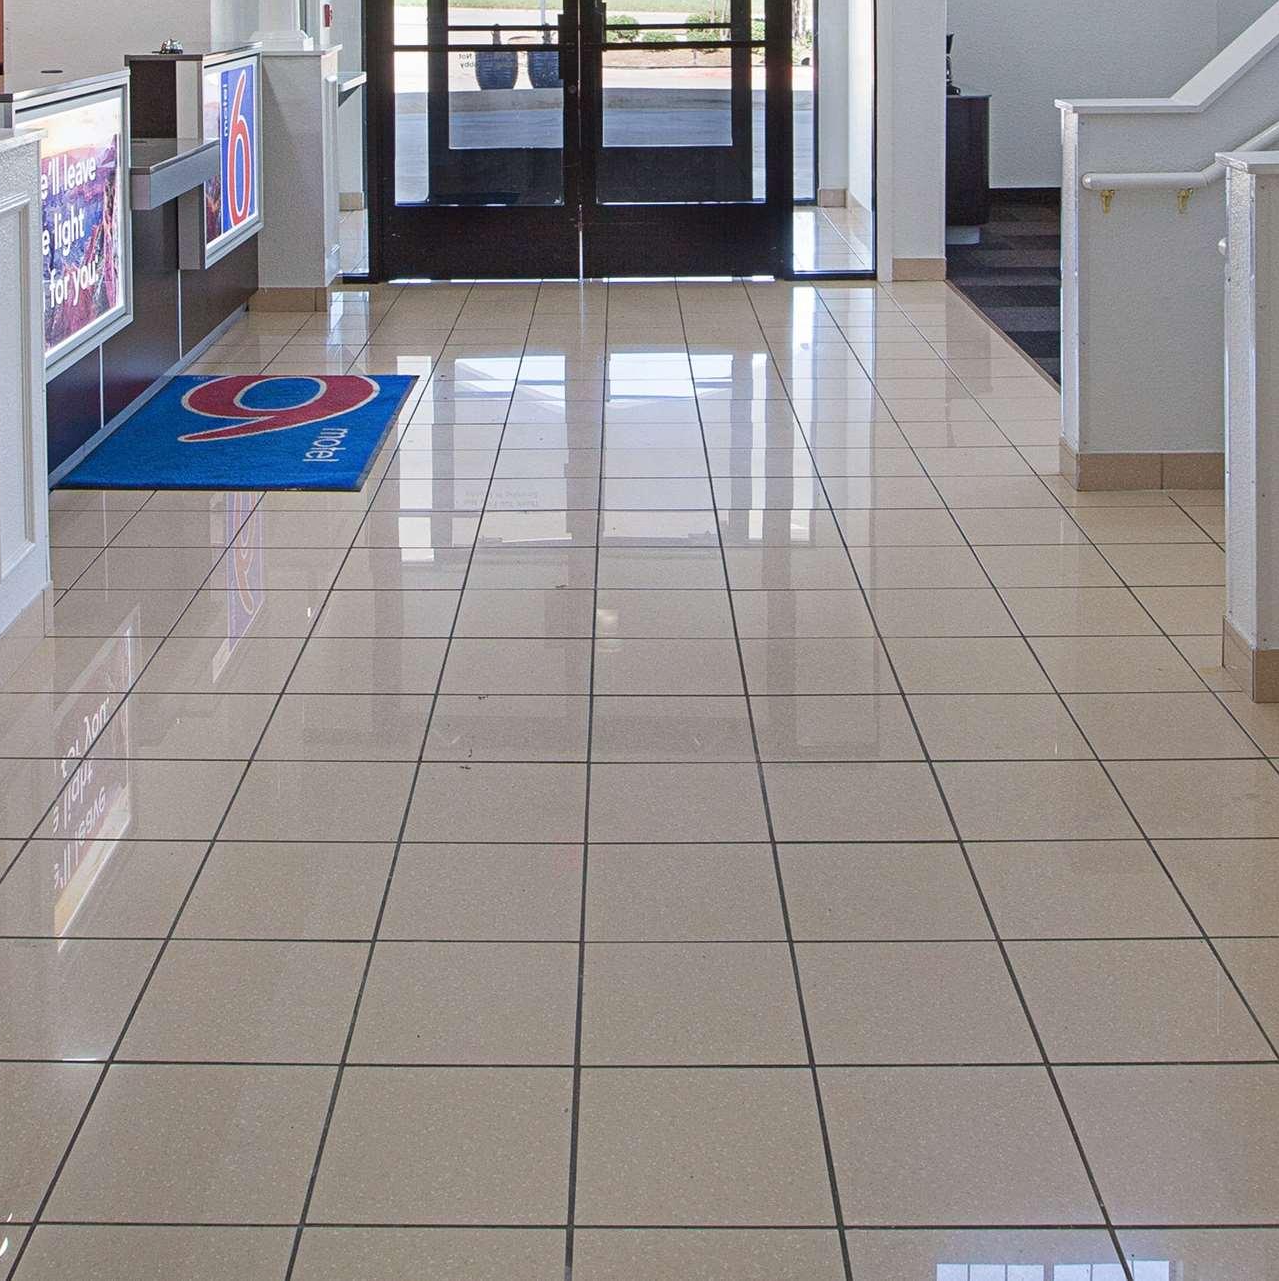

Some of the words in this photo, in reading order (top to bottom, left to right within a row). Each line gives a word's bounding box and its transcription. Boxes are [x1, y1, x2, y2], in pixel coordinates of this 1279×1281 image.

[227, 69, 252, 229] 6
[41, 156, 60, 200] e'll
[64, 153, 97, 191] leave
[54, 205, 85, 257] light
[49, 268, 70, 308] for
[177, 375, 380, 442] 6
[302, 427, 349, 462] motel
